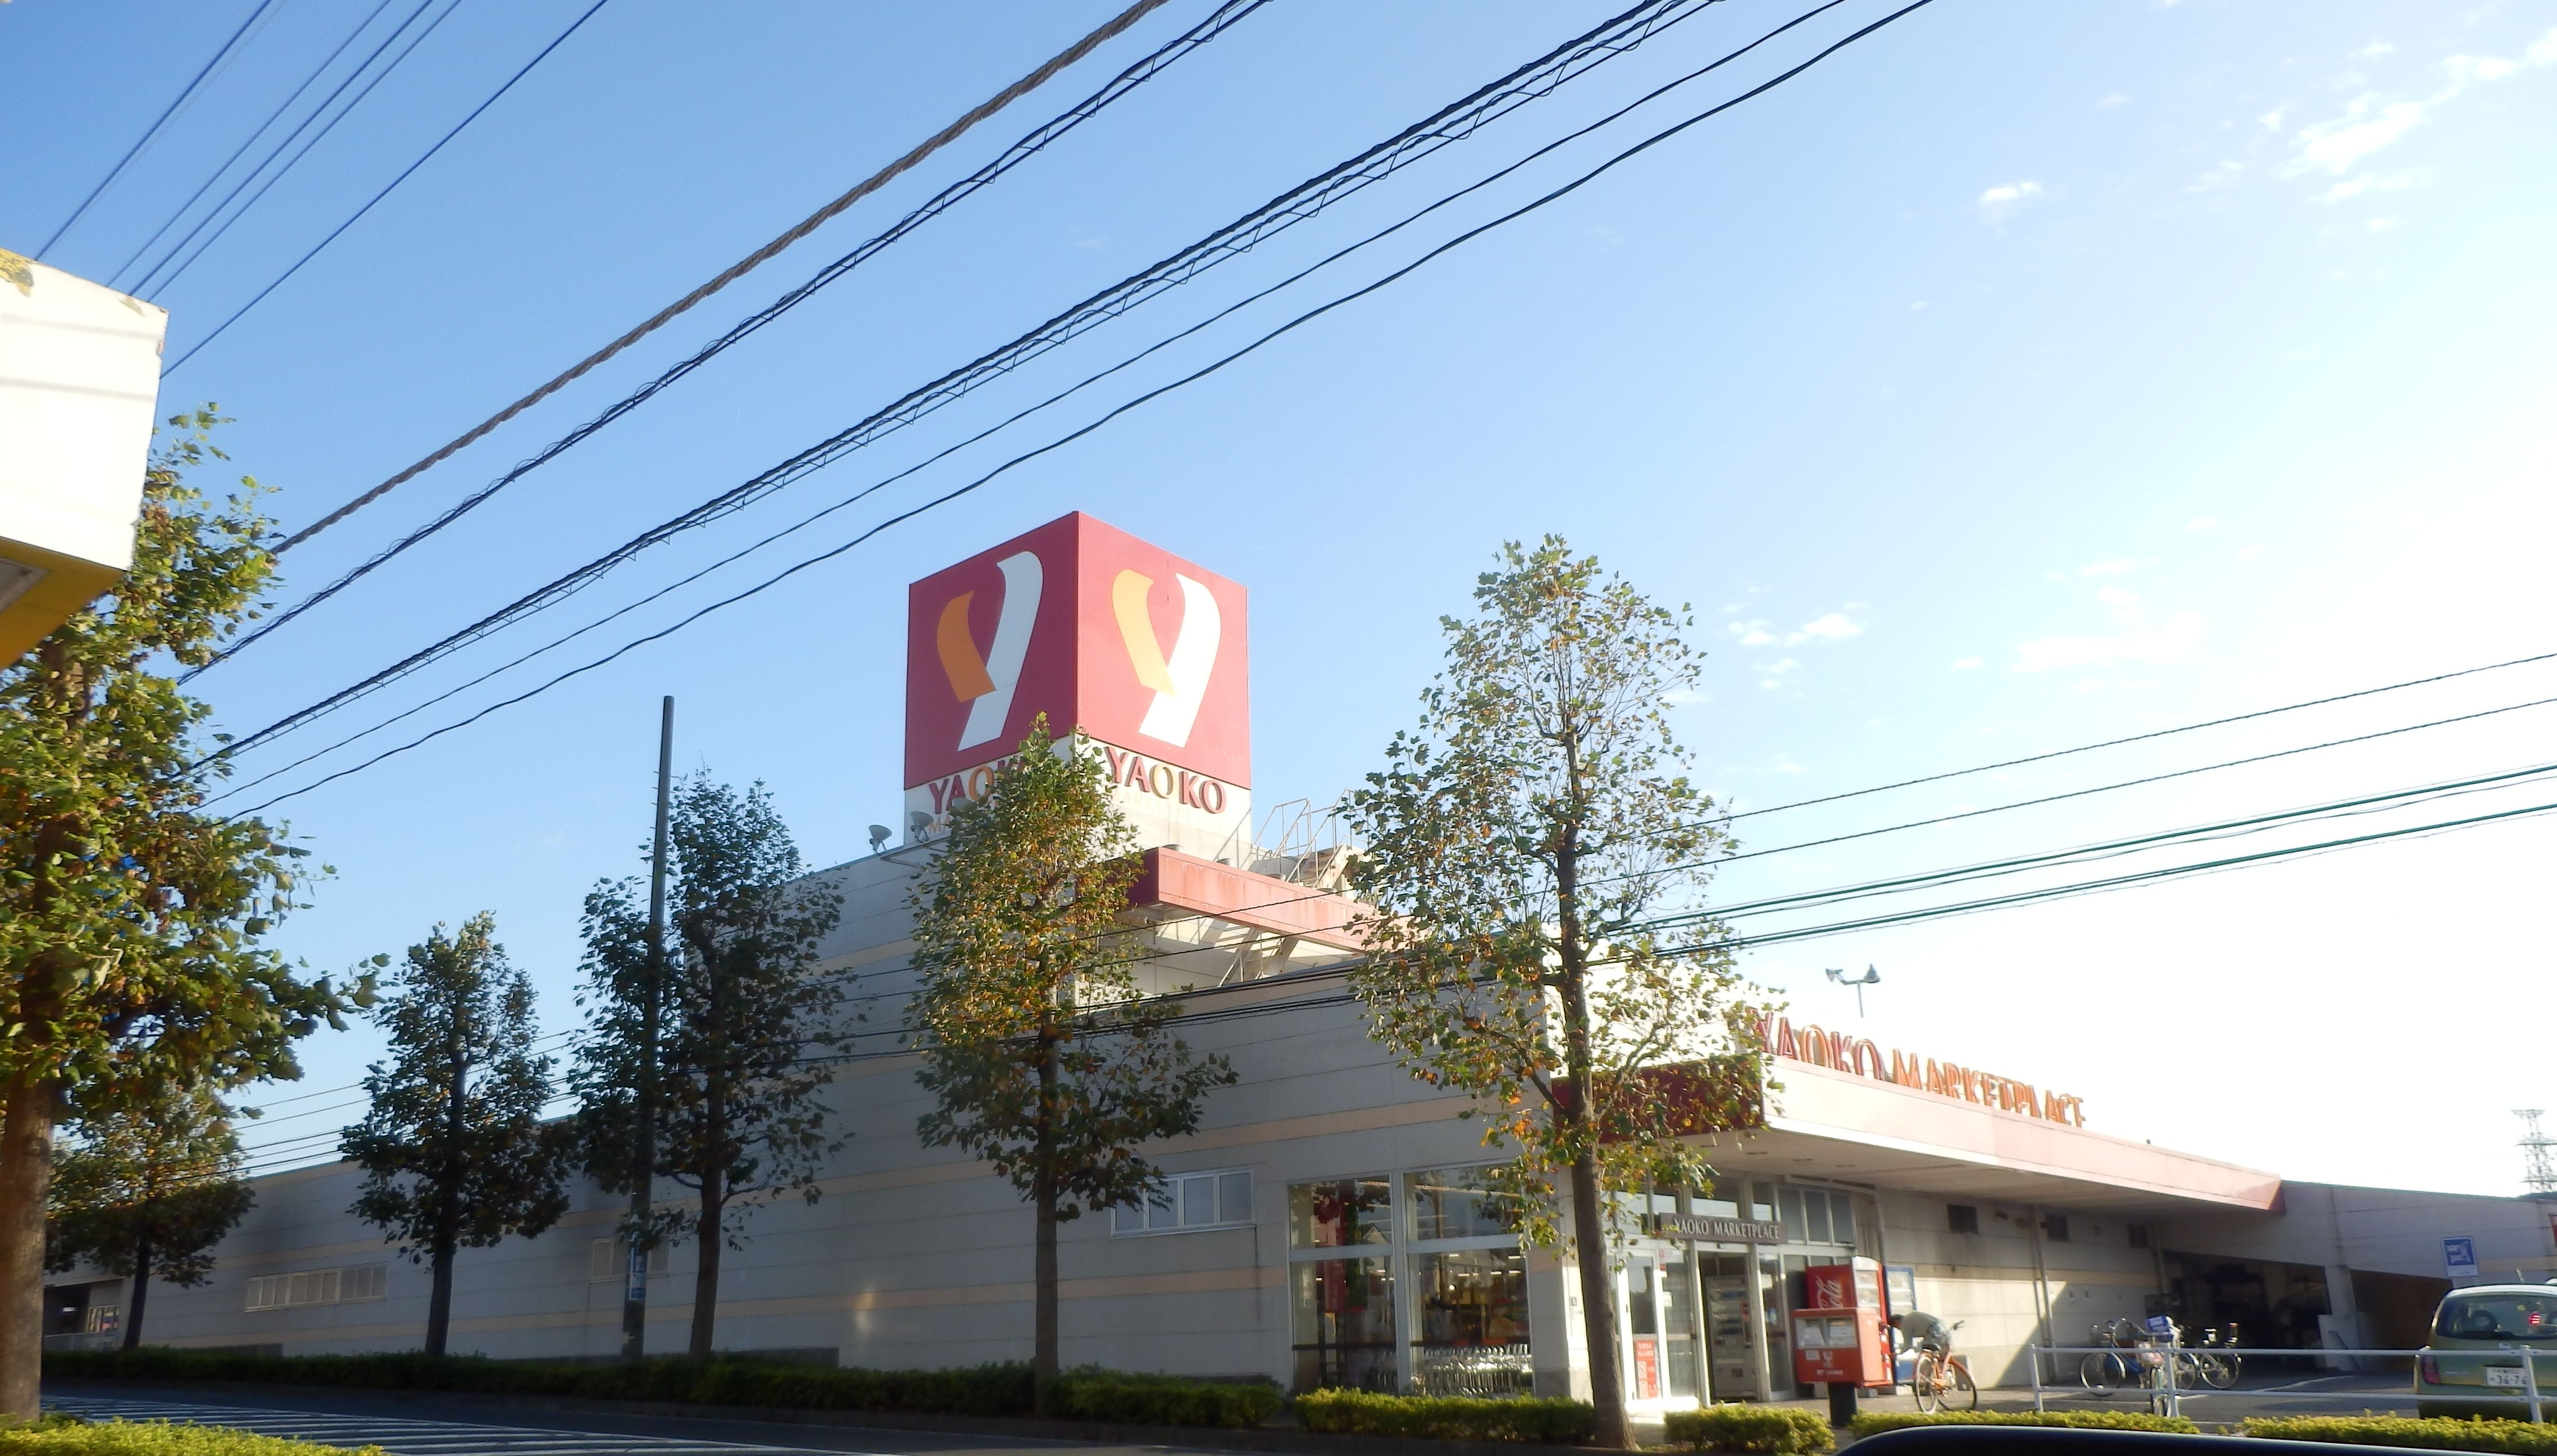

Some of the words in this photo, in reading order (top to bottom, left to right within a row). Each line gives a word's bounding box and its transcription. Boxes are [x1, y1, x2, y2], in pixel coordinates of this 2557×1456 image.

[929, 757, 1027, 815] YAO
[1103, 746, 1227, 814] YAOKO
[1673, 1218, 1709, 1235] YAOKO
[1714, 1221, 1780, 1240] MARKETPLACE
